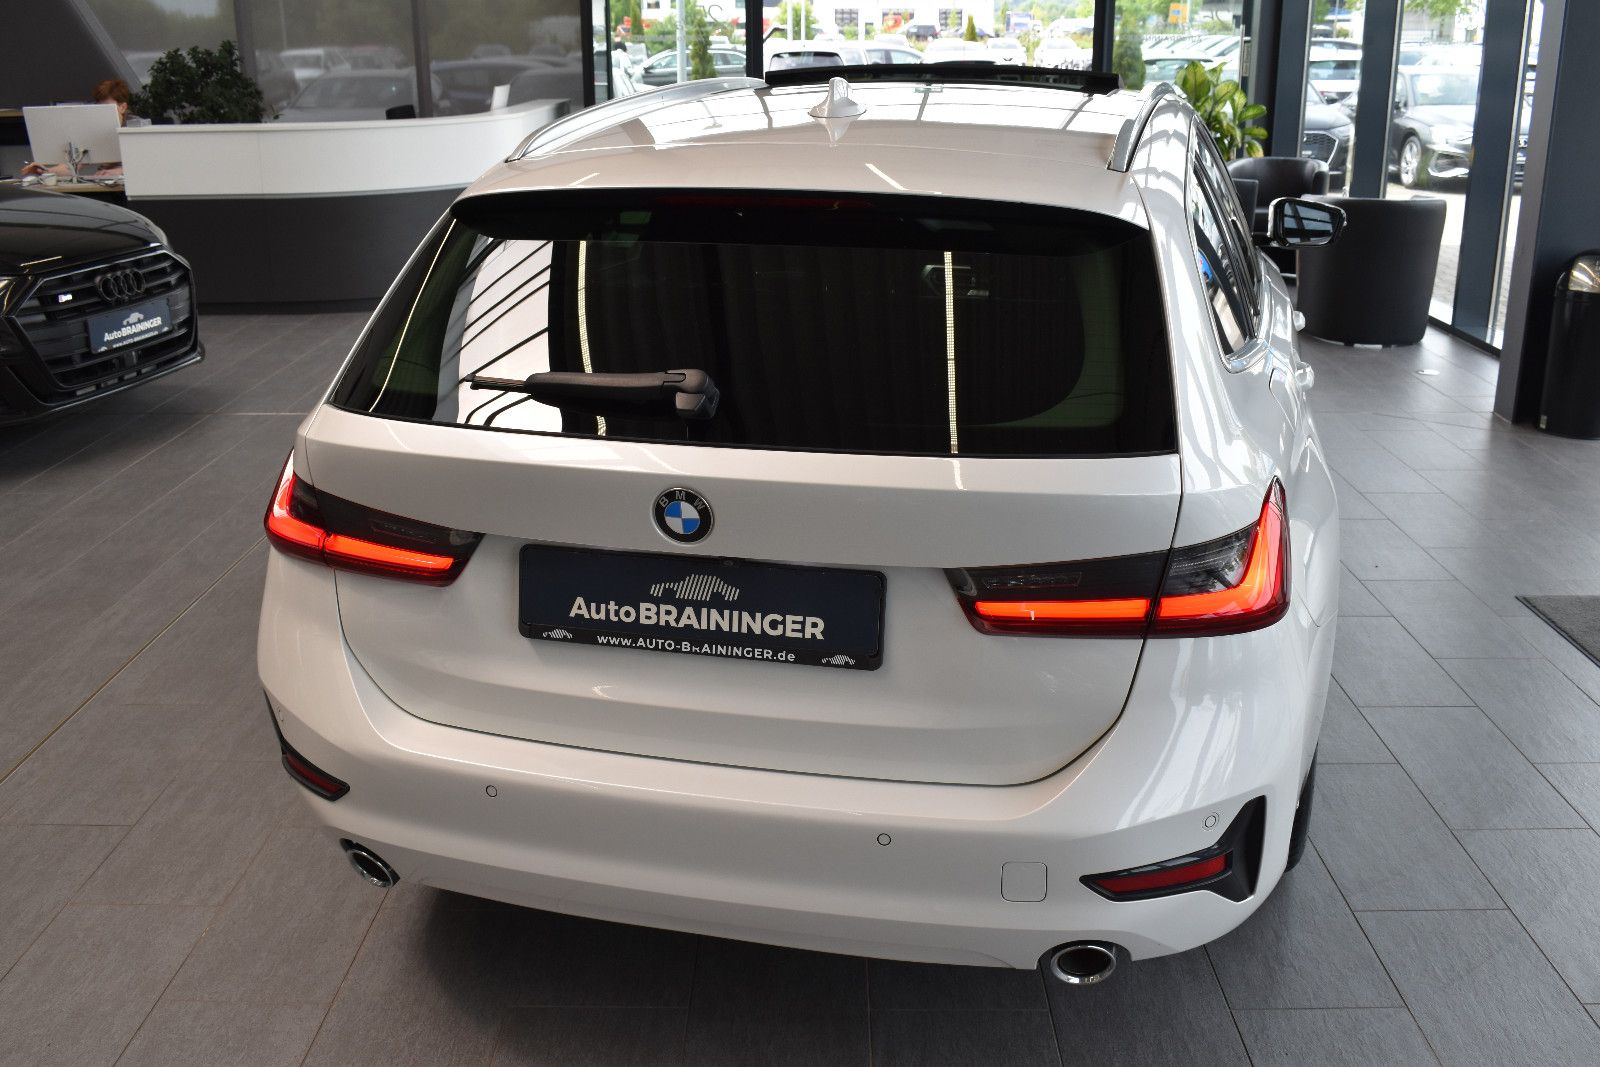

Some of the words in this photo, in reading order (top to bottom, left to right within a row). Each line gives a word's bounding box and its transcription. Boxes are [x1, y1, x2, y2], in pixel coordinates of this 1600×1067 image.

[104, 316, 162, 342] AutoBRAININGER
[659, 490, 705, 510] BMW
[568, 596, 825, 640] AutoBRAININGER
